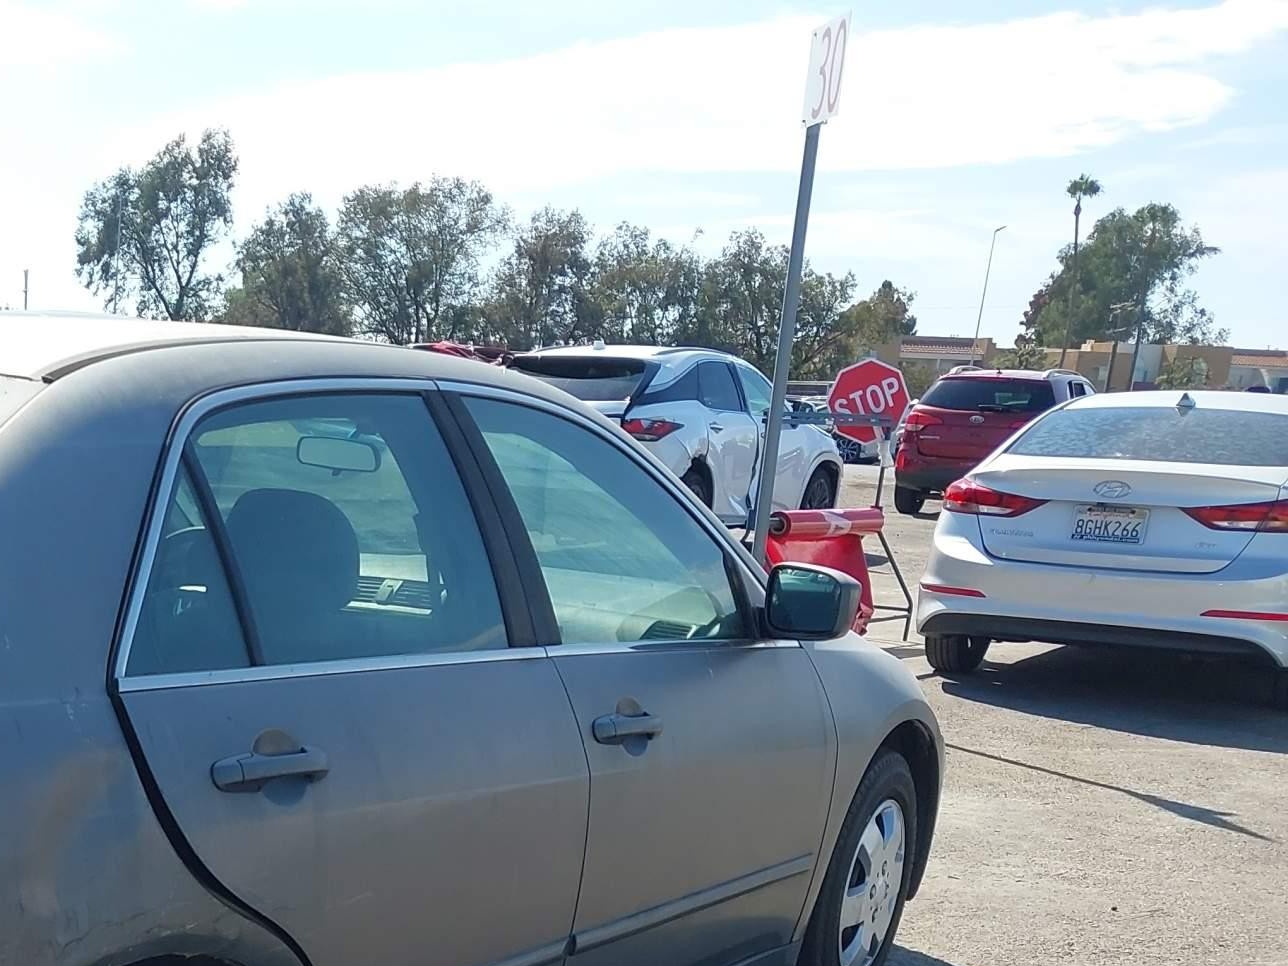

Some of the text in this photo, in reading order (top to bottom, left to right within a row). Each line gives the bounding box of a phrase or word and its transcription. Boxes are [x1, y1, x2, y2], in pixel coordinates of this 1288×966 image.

[811, 18, 847, 120] 30
[834, 377, 900, 416] STOP
[1074, 518, 1141, 538] 8GHK266
